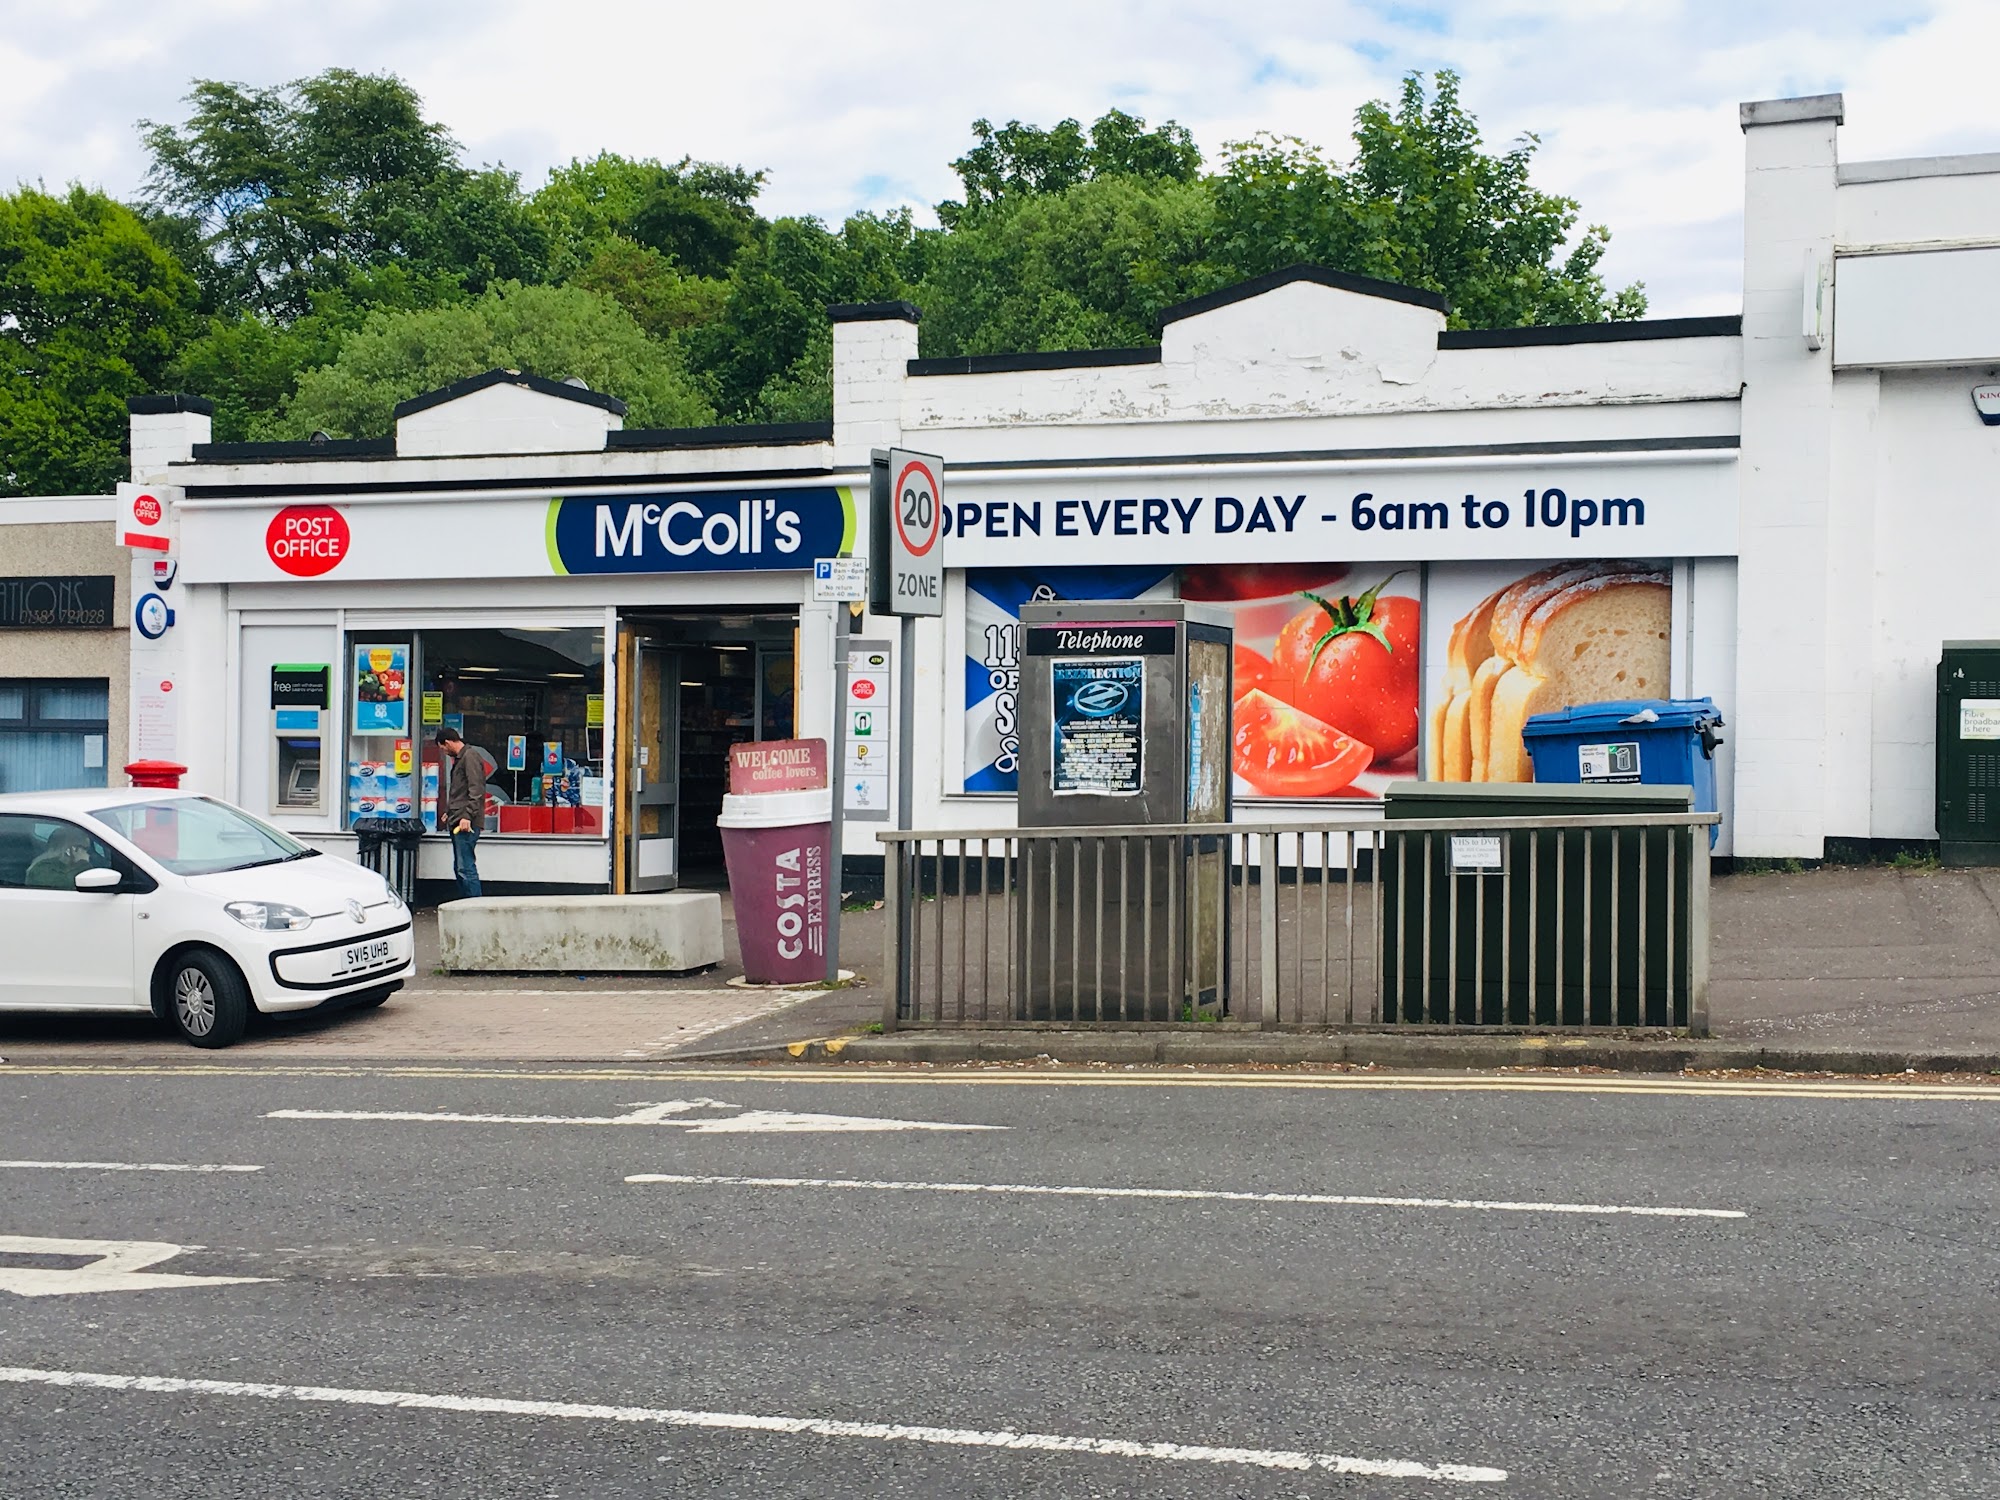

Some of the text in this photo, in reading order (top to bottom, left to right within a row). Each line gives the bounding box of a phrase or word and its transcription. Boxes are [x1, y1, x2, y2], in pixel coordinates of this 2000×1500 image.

[135, 508, 159, 520] OFFICE
[139, 500, 157, 511] POST
[903, 488, 931, 529] 20
[1055, 497, 1203, 537] EVERY
[1214, 495, 1307, 534] DAY
[1321, 514, 1337, 522] -
[1351, 492, 1449, 531] 6am
[1461, 494, 1510, 529] to
[1523, 488, 1645, 538] 10pm
[285, 517, 334, 536] POST
[595, 500, 801, 557] McColl's
[273, 538, 340, 558] OFFICE
[898, 573, 937, 598] ZONE
[1056, 630, 1144, 652] Telephone
[273, 681, 292, 692] free
[736, 748, 810, 767] WELCOME
[752, 766, 817, 780] coffee lovers
[1452, 838, 1470, 846] VHS
[1480, 838, 1501, 846] DVD
[807, 845, 822, 923] EXPRESS
[775, 847, 806, 960] COSTA
[347, 942, 389, 964] SV15 UHB
